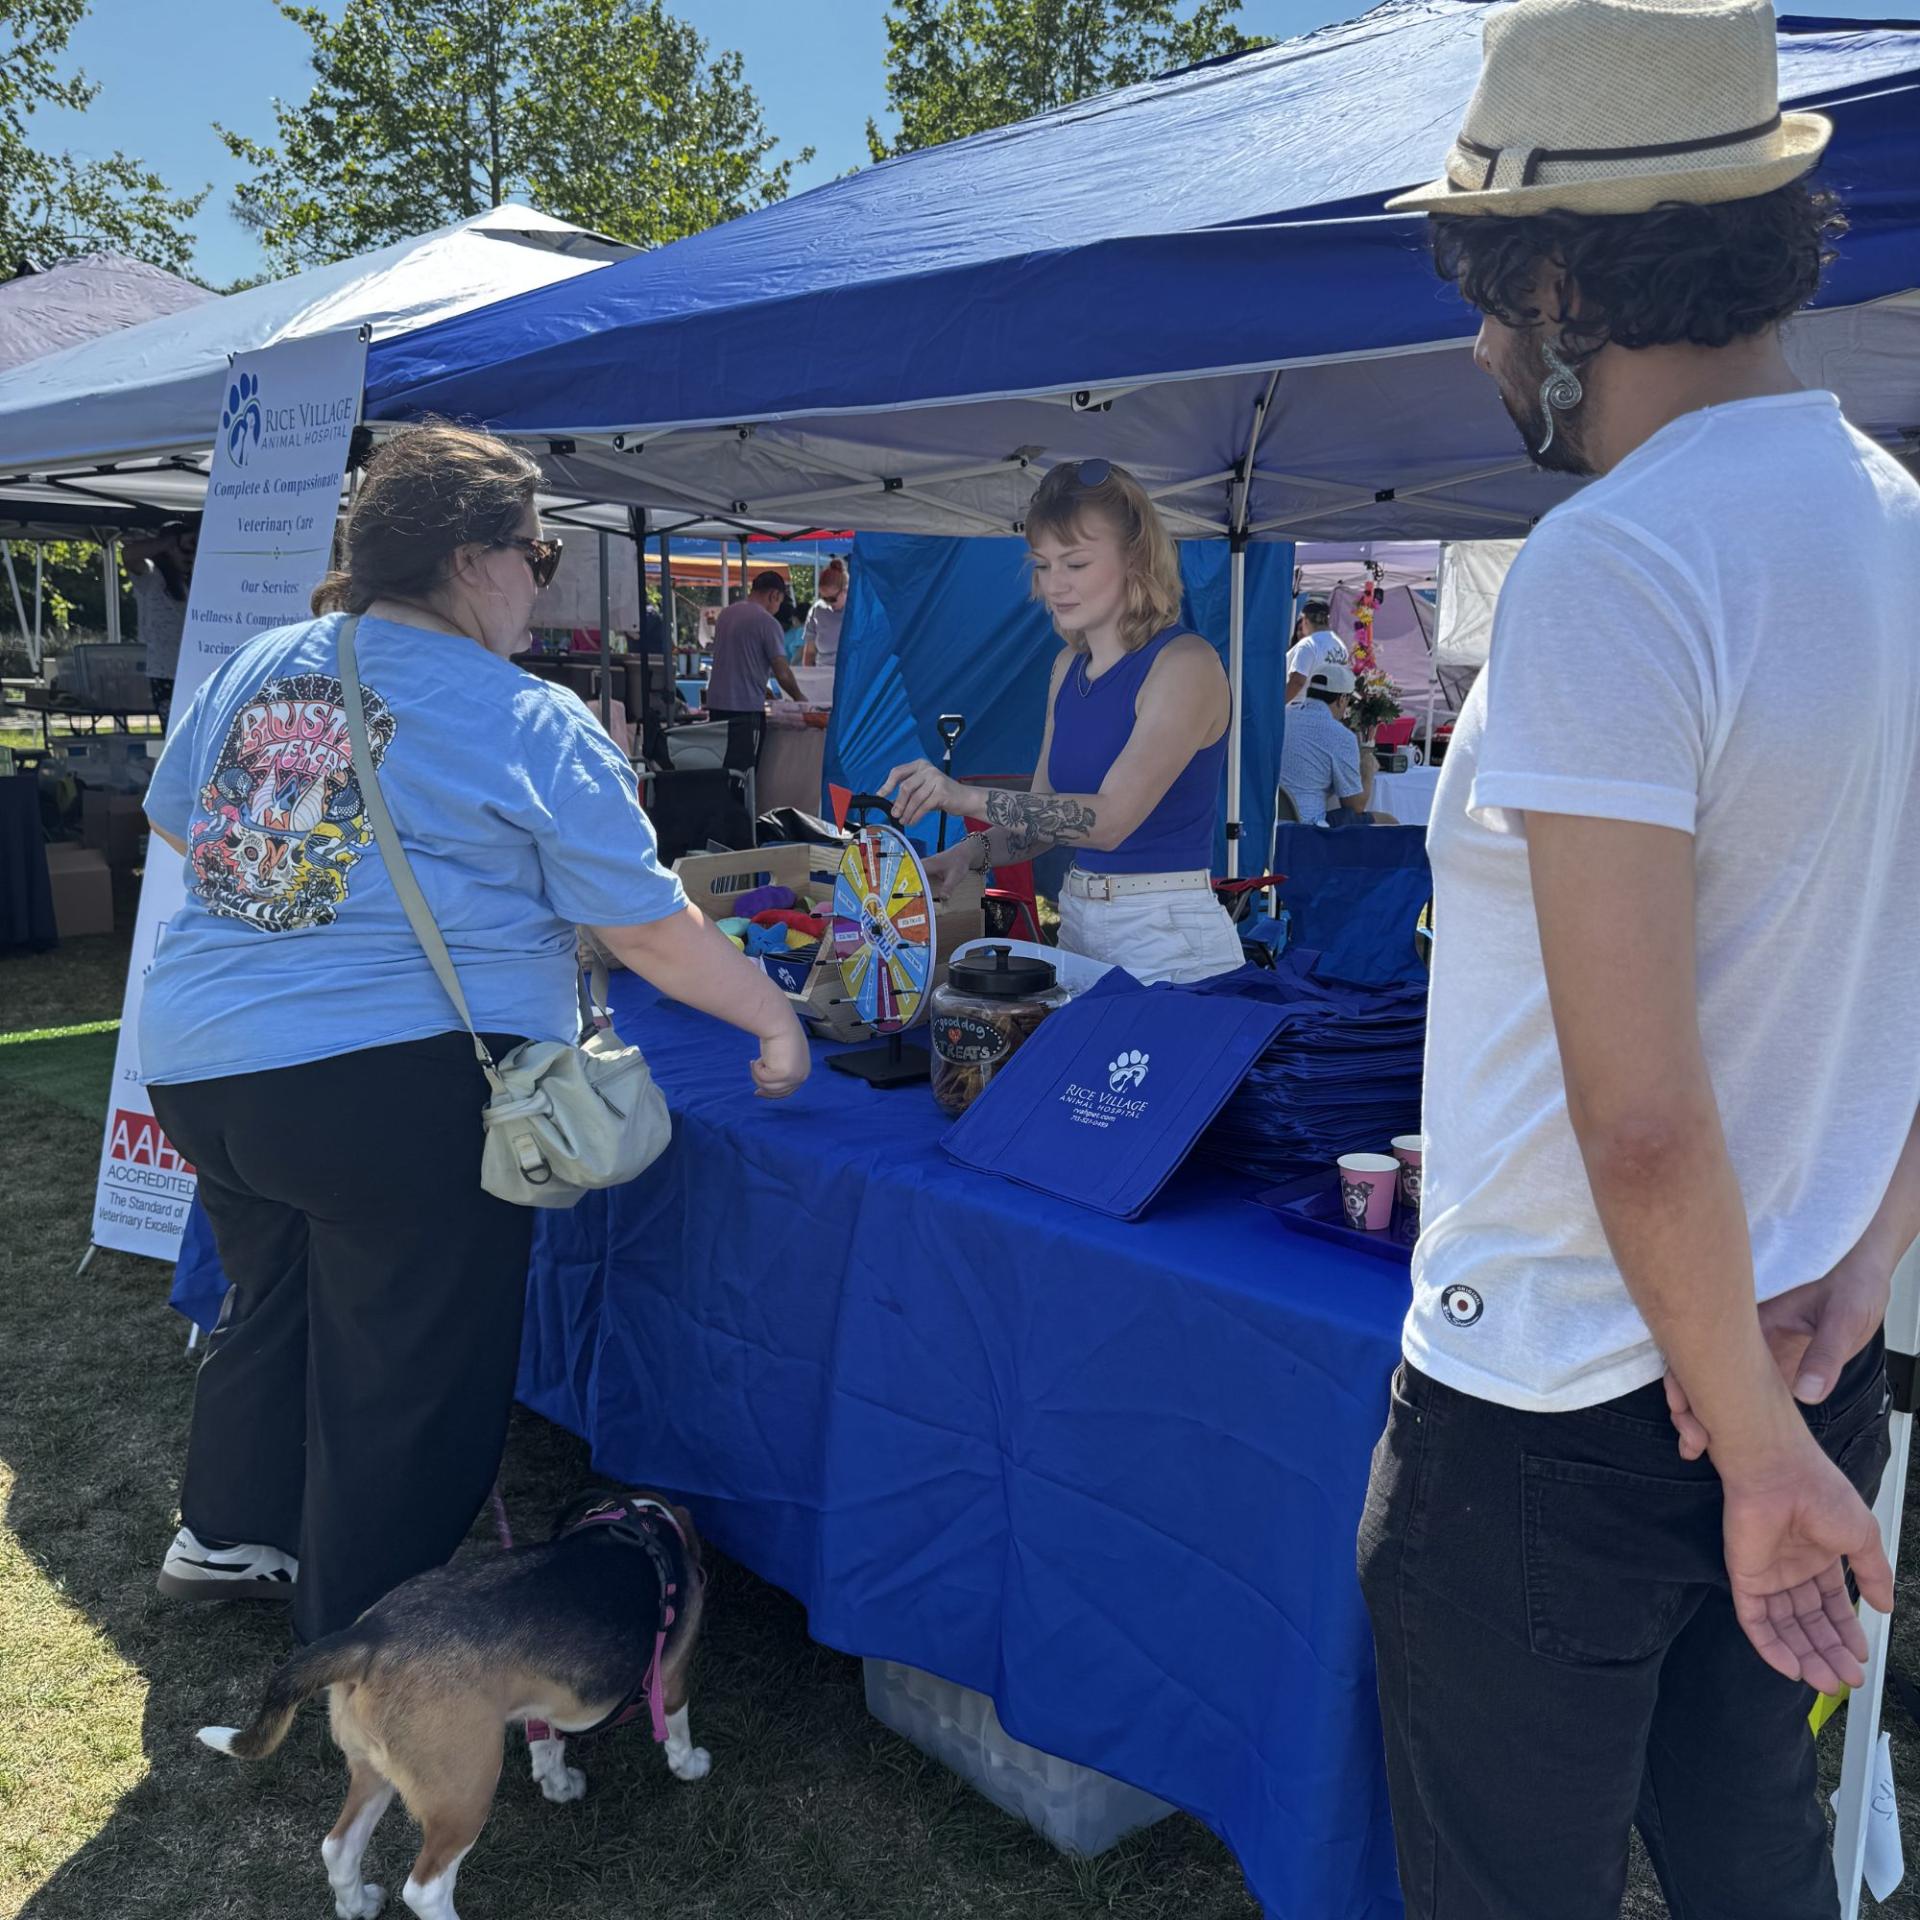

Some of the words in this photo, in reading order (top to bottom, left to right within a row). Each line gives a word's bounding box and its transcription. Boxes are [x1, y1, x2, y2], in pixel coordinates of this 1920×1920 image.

[266, 409, 295, 432] RICE
[299, 398, 353, 427] VILLAGE
[261, 434, 301, 450] ANIMAL
[304, 425, 348, 445] HOSPITAL
[214, 481, 261, 499] Complete
[263, 479, 270, 494] &
[273, 472, 339, 496] Compassionate
[238, 516, 294, 536] Veterinary
[296, 515, 314, 530] Care
[241, 579, 260, 593] Our
[191, 608, 233, 624] Wellness
[235, 611, 243, 625] &
[198, 640, 239, 655] Vaccina
[240, 700, 353, 759] AUST
[939, 1016, 960, 1032] good
[961, 1019, 986, 1039] dog
[938, 1041, 990, 1060] TREATS
[1059, 1095, 1094, 1109] ANIMAL
[1097, 1104, 1140, 1119] HOSPITAL
[1065, 1084, 1096, 1101] RICE
[1099, 1092, 1149, 1112] VILLAGE
[110, 1119, 187, 1172] AAH
[107, 1164, 196, 1195] ACCREDITED
[110, 1191, 127, 1208] The
[128, 1196, 172, 1217] Standard
[174, 1206, 184, 1219] of
[99, 1206, 142, 1230] Veterinary
